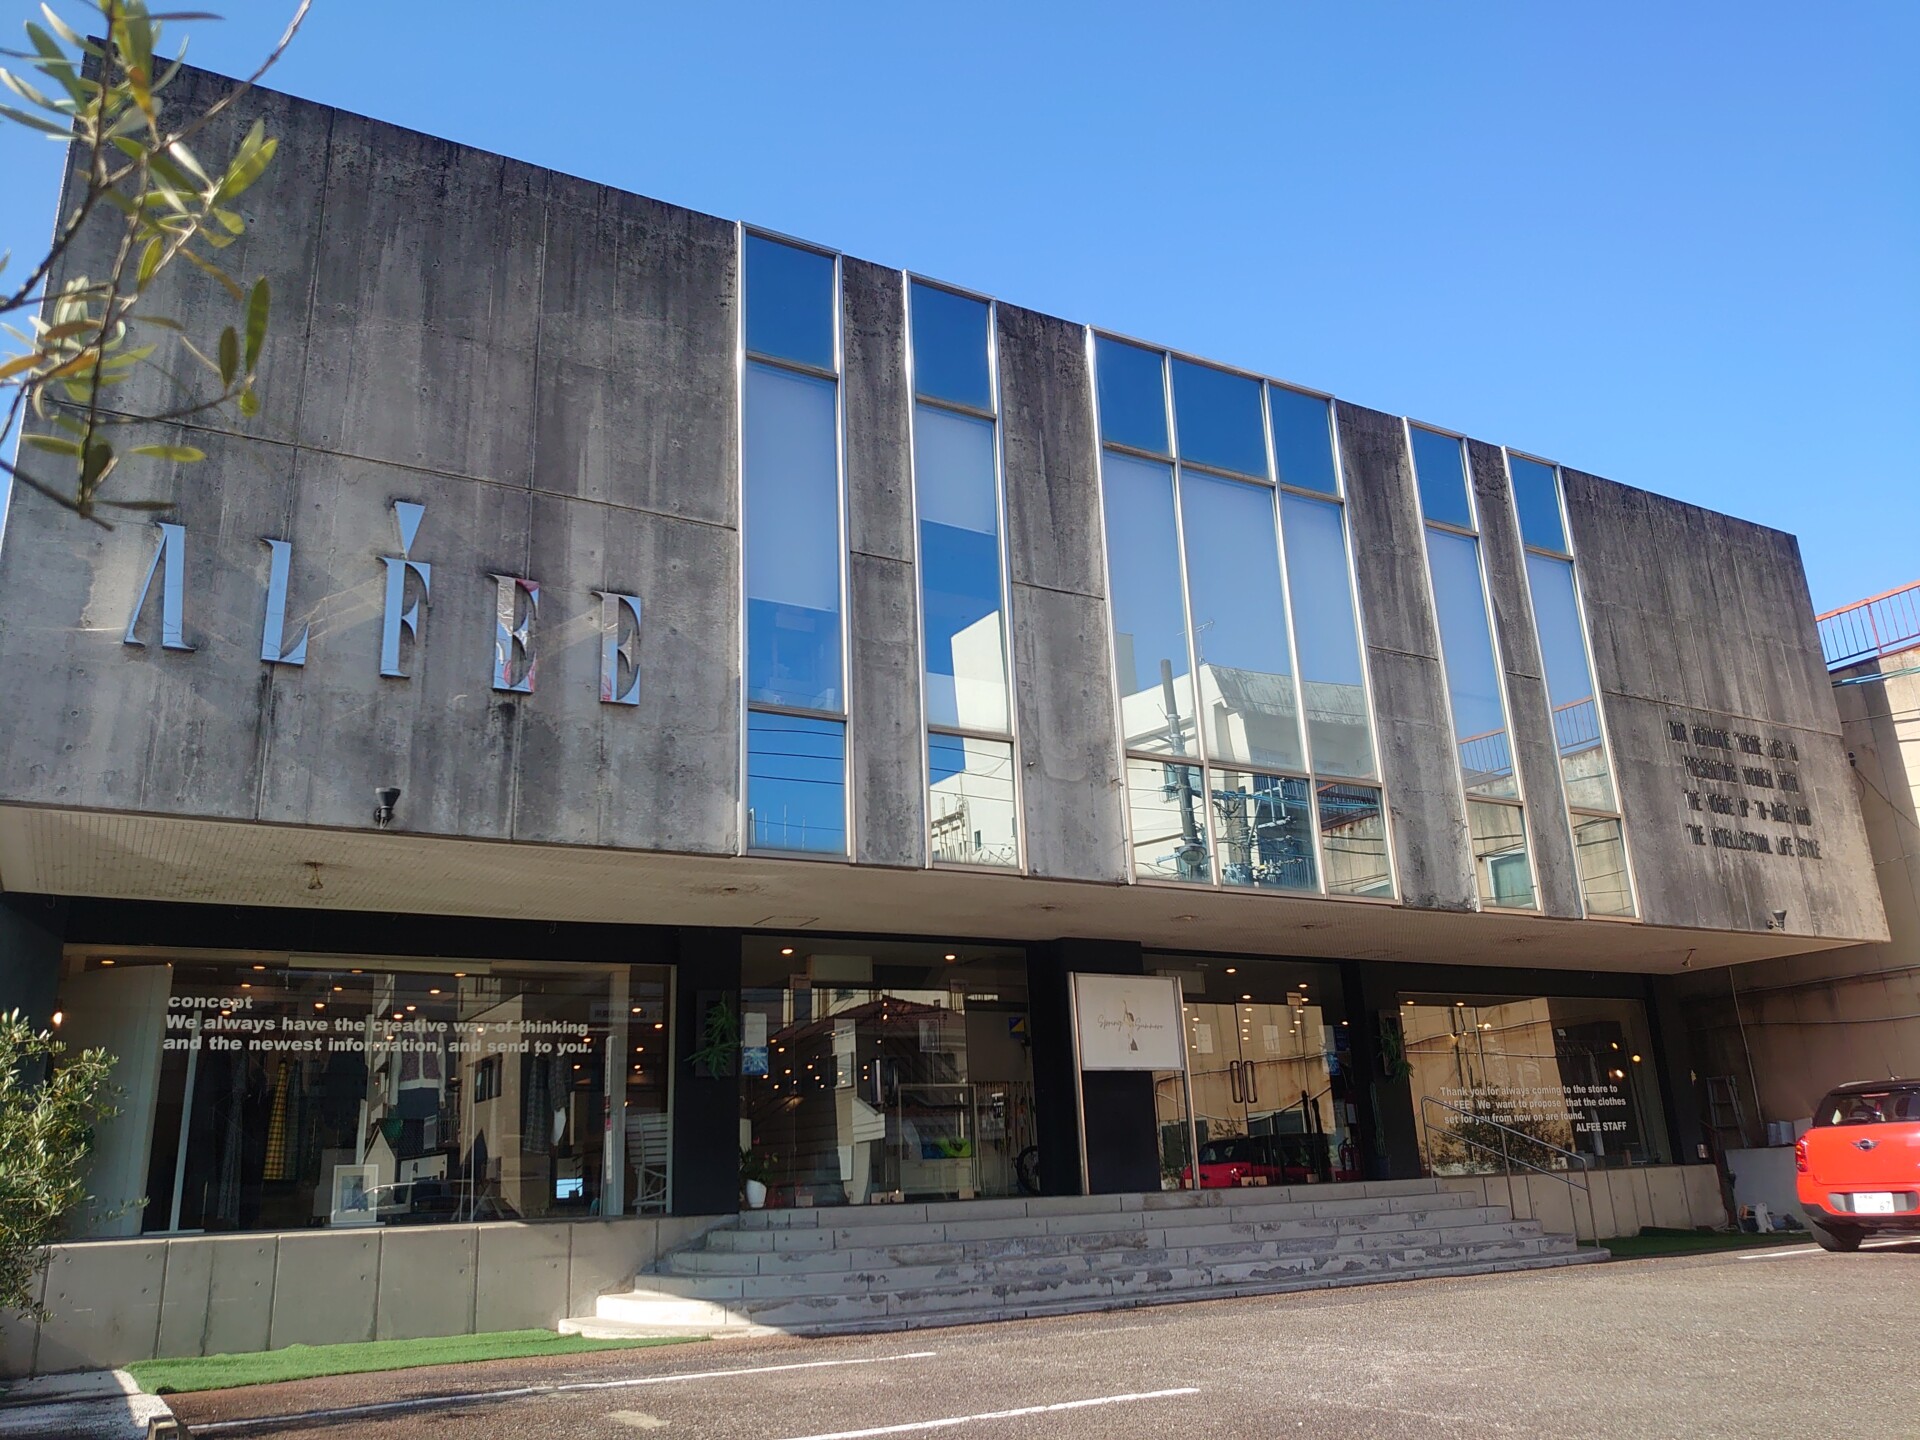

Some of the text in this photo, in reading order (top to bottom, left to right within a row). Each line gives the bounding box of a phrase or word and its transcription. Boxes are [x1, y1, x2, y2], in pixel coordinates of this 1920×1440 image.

[1683, 789, 1702, 811] THE
[1685, 823, 1706, 846] THE
[167, 995, 253, 1012] concept
[166, 1014, 589, 1036] We always have the creative way of thinking
[163, 1036, 593, 1056] and the newest information, and send to you.
[1440, 1084, 1618, 1098] Thank you for always coming to the store to
[1477, 1100, 1491, 1109] We
[1495, 1100, 1517, 1109] want
[1518, 1100, 1527, 1108] to
[1529, 1101, 1561, 1110] propose
[1565, 1097, 1582, 1107] that
[1583, 1097, 1597, 1107] the
[1598, 1096, 1626, 1106] clothes
[1444, 1114, 1459, 1124] set
[1461, 1113, 1473, 1123] for
[1492, 1112, 1512, 1122] from
[1513, 1113, 1531, 1122] now
[1533, 1113, 1544, 1121] on
[1545, 1112, 1559, 1121] are
[1561, 1110, 1586, 1121] found.
[1576, 1121, 1627, 1132] ALFEE STAFF
